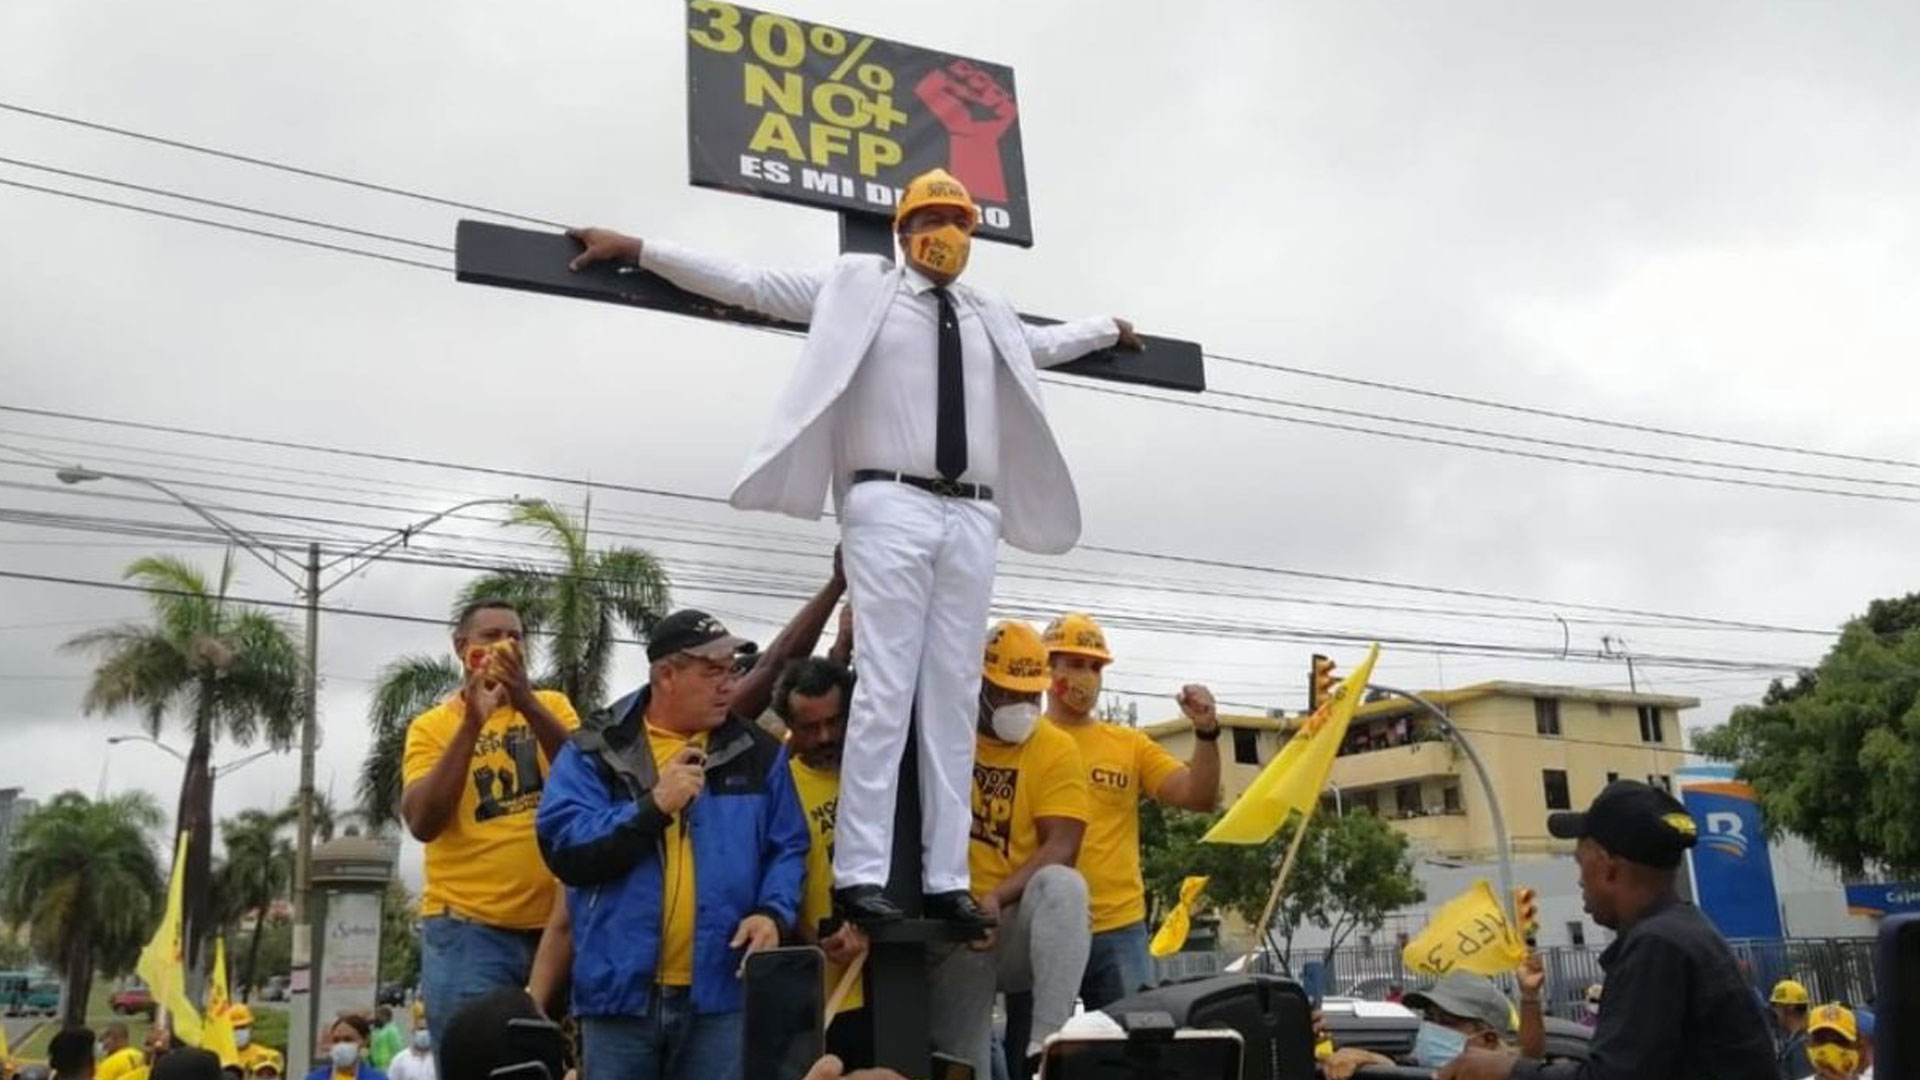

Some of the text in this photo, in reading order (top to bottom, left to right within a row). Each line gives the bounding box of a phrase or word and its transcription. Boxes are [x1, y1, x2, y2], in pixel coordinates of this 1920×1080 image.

[689, 1, 894, 92] 30%
[744, 63, 908, 131] NO+
[740, 154, 792, 184] ES
[802, 168, 855, 198] MI
[749, 112, 902, 177] AFP
[1092, 768, 1128, 788] CTU
